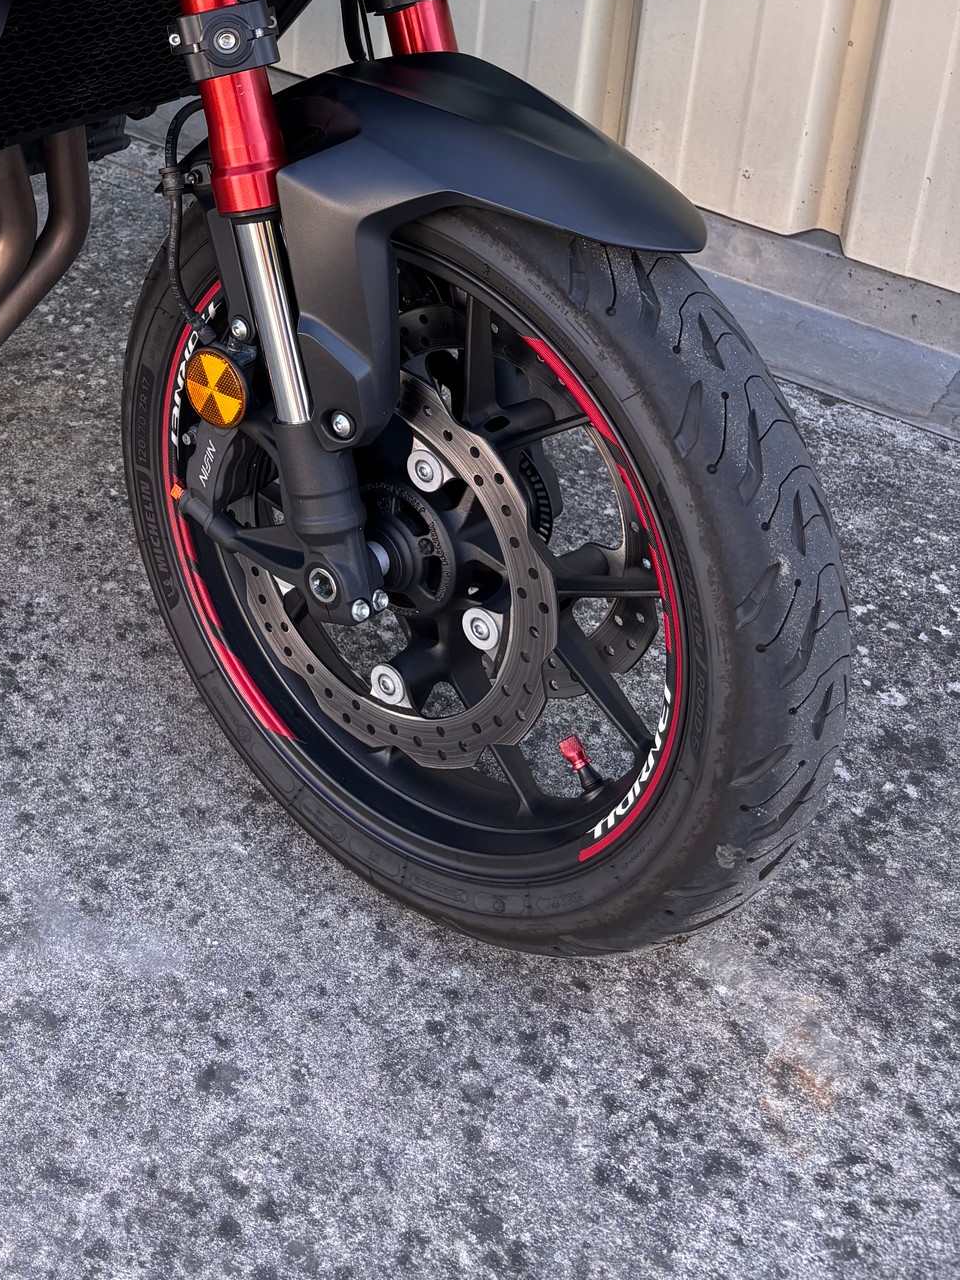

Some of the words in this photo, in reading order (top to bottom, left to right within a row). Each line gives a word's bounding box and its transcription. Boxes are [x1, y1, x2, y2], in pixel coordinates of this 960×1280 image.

[138, 394, 149, 415] ZR
[141, 376, 152, 392] 17
[136, 416, 148, 464] 120/70
[140, 480, 169, 574] MICHELIN
[693, 675, 706, 736] ROAD
[584, 683, 672, 840] HORNET
